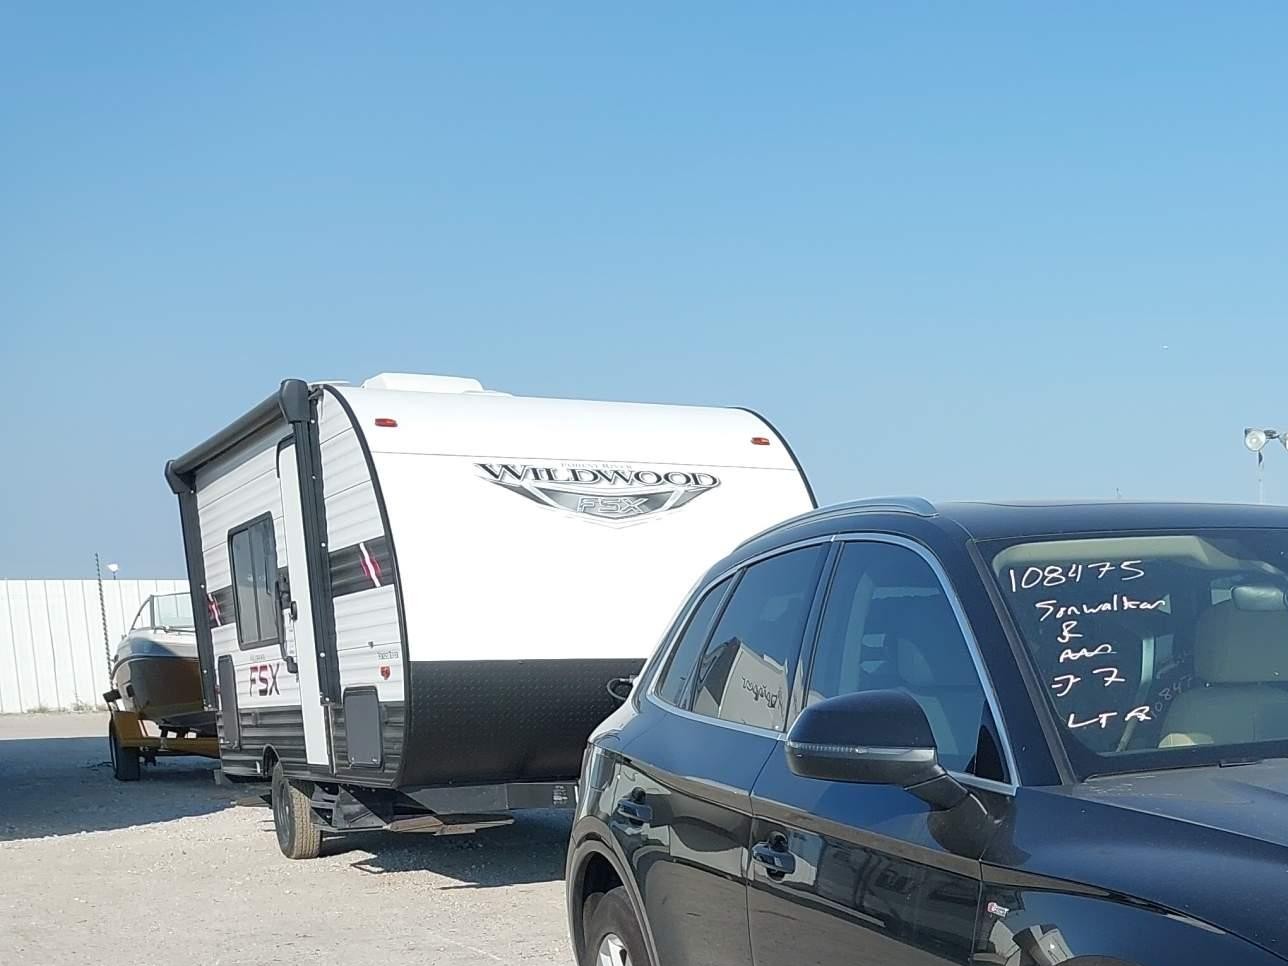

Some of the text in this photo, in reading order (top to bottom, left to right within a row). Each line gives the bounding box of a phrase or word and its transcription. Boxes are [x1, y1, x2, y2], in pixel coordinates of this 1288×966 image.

[474, 462, 721, 487] WILDWOOD
[576, 497, 648, 514] FSX
[1009, 560, 1145, 592] 108475
[249, 664, 280, 696] FSX
